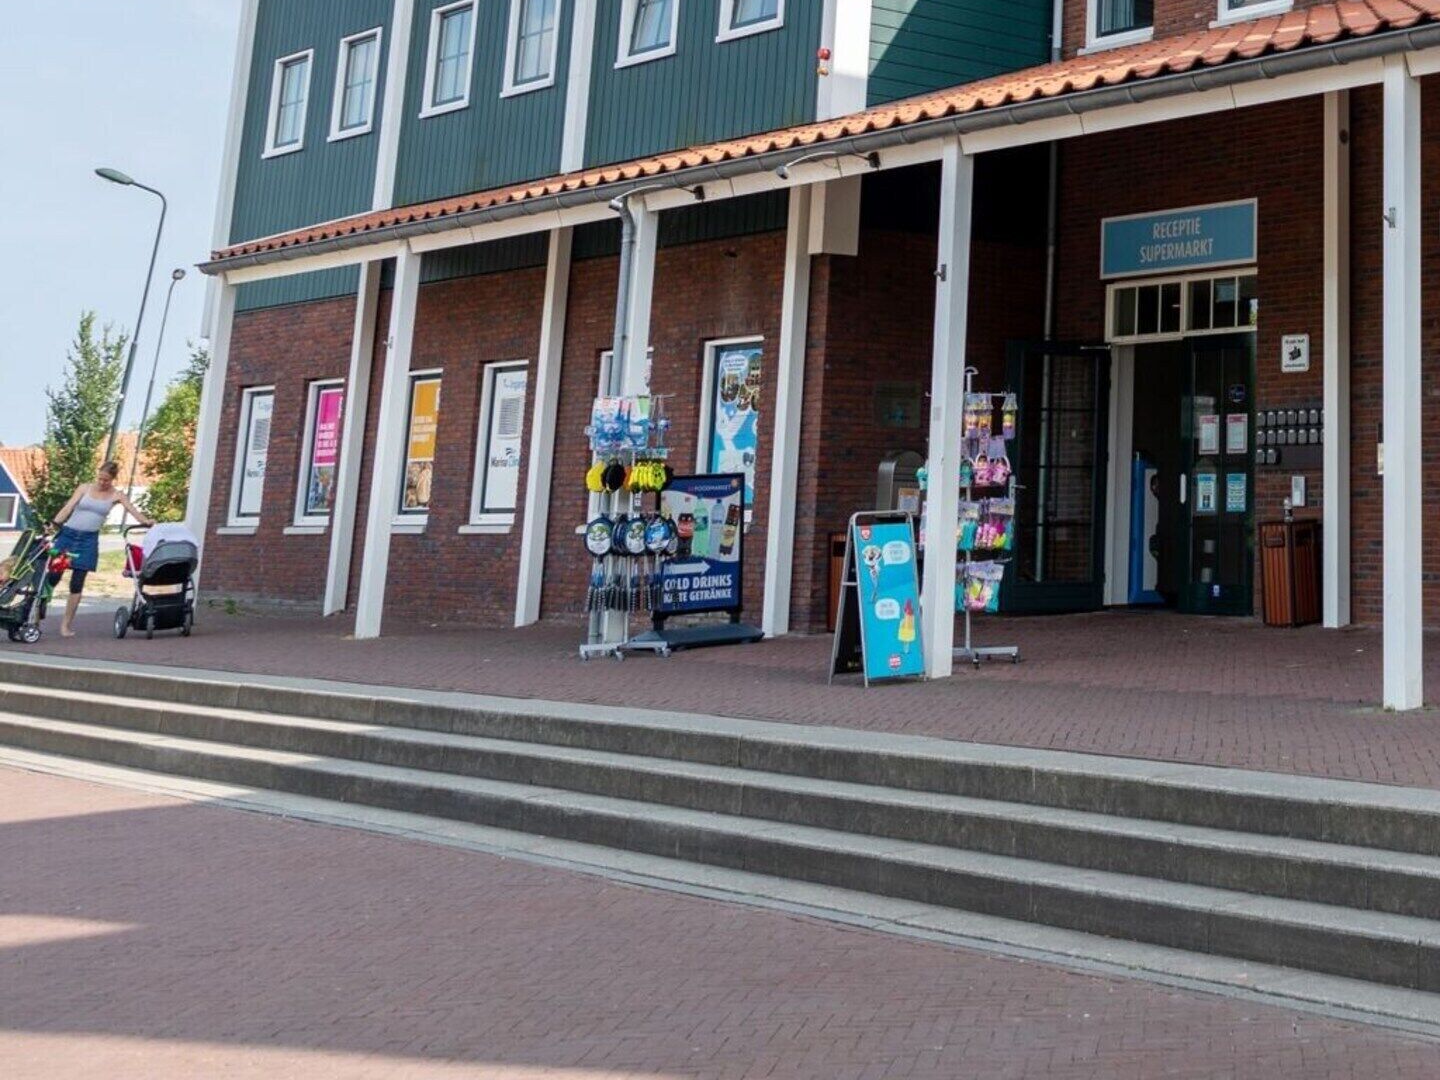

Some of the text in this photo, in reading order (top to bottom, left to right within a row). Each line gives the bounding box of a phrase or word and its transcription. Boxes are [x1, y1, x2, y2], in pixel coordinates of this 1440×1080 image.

[1153, 217, 1201, 239] RECEPTIE
[1140, 238, 1213, 262] SUPERMARKT
[692, 574, 732, 589] DRINKS
[663, 588, 732, 603] KTE GETRÄNKE
